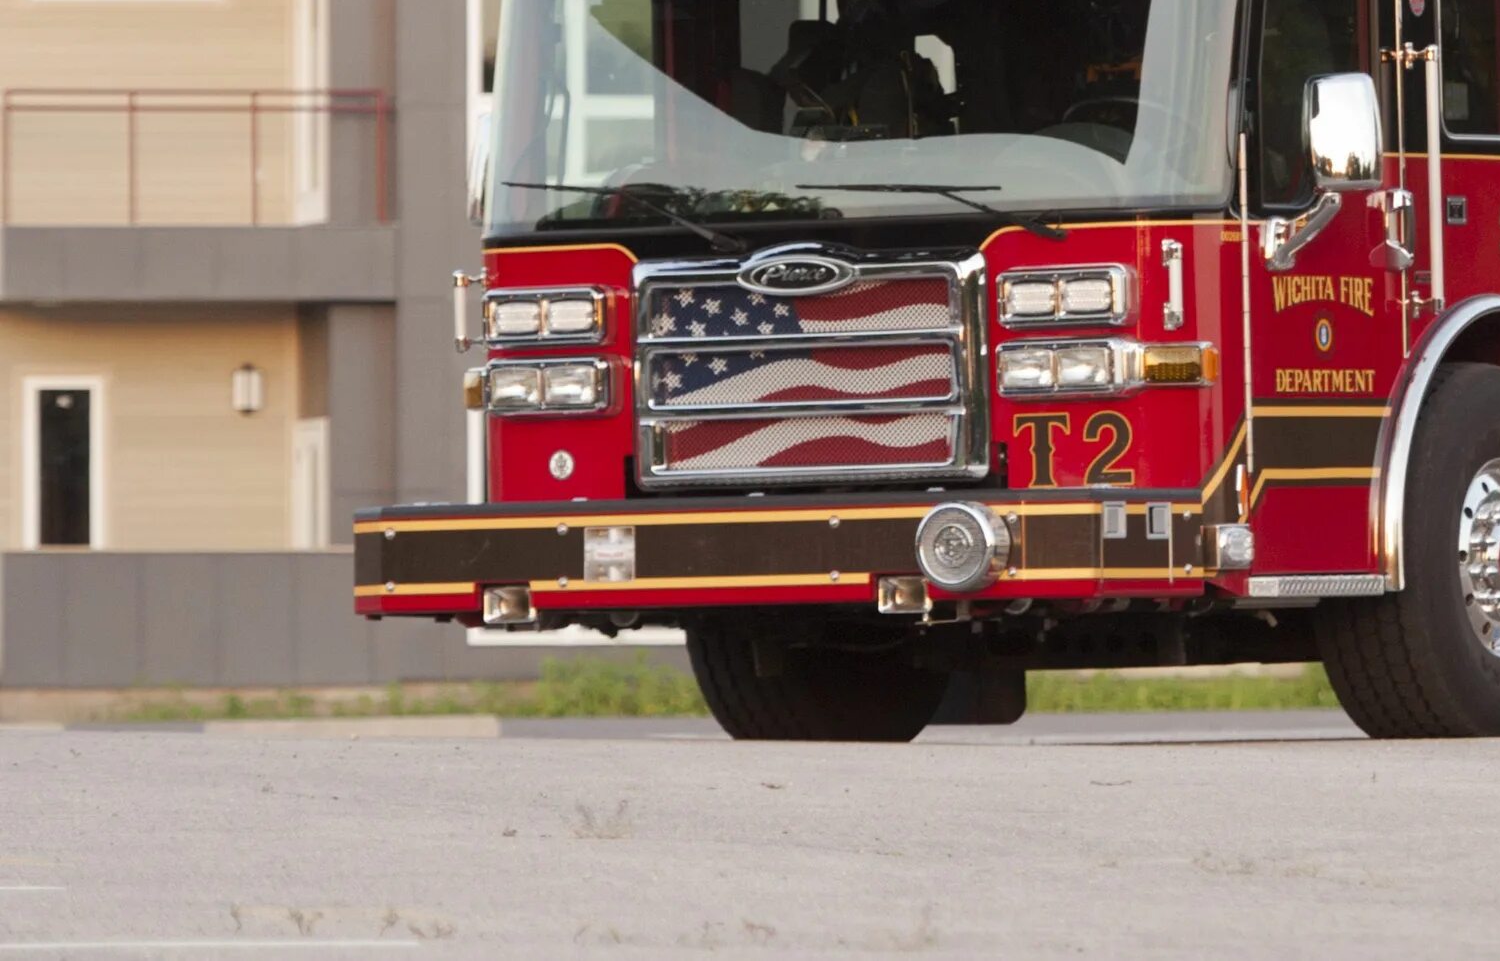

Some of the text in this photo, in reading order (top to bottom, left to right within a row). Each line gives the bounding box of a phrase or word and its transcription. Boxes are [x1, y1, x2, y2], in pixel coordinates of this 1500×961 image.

[760, 263, 828, 286] Pierce
[1272, 275, 1374, 317] WICHITA FIRE
[1275, 368, 1376, 393] DEPARTMENT
[1013, 411, 1136, 489] T 2
